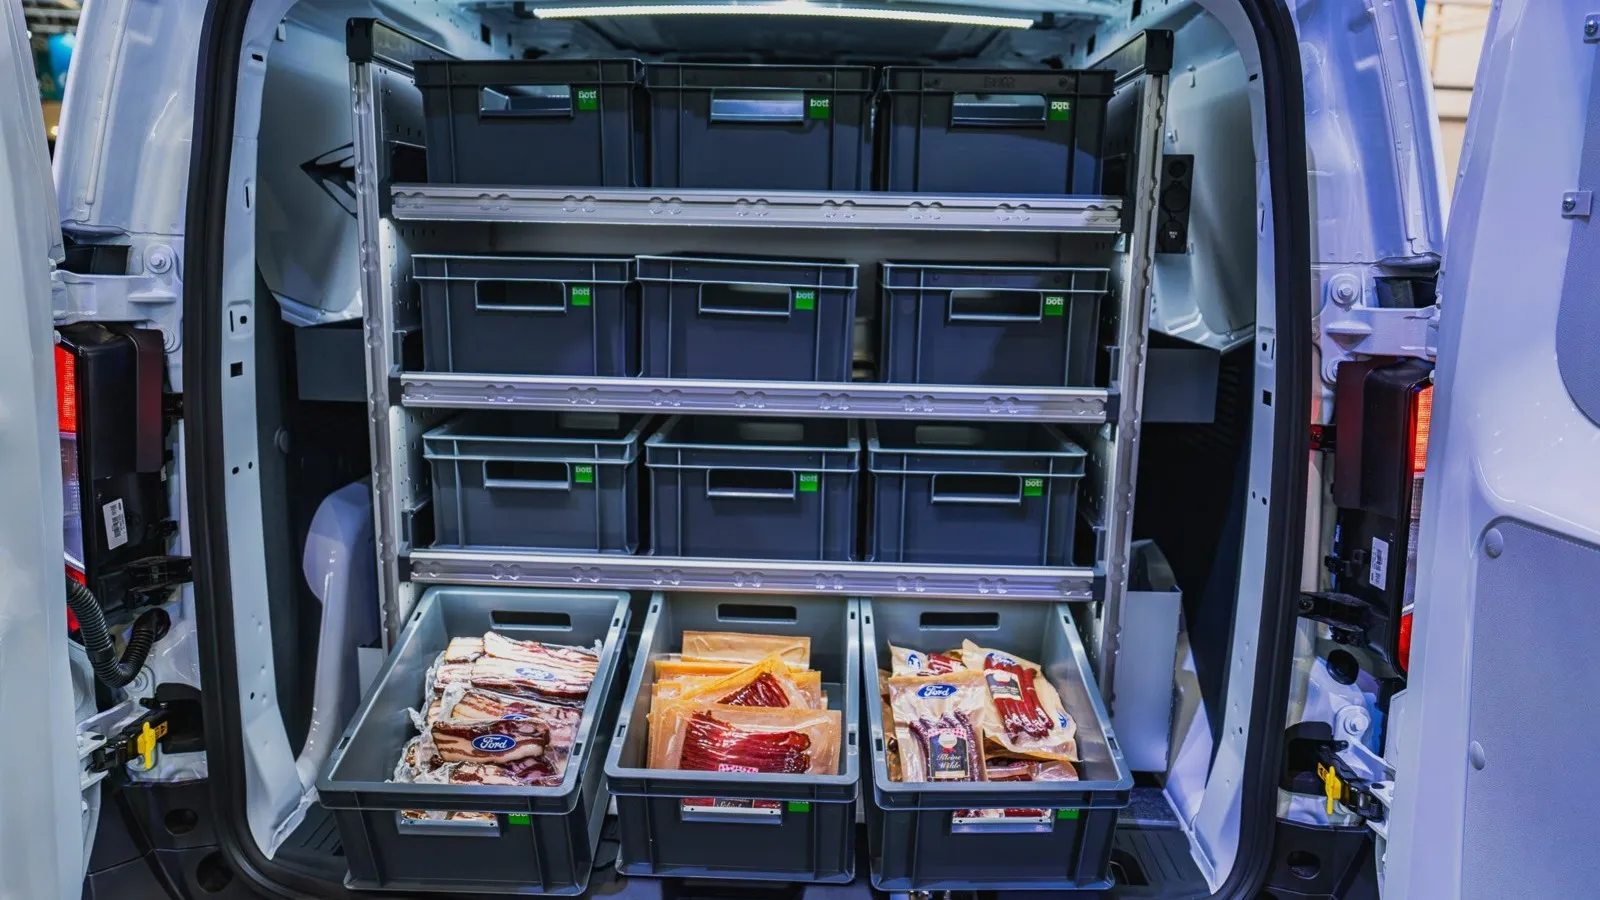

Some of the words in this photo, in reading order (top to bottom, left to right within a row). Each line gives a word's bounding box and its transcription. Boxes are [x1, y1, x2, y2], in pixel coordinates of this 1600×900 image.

[810, 98, 830, 108] bott
[572, 287, 591, 296] bott
[796, 291, 815, 300] bott
[1046, 297, 1064, 306] bott
[575, 465, 592, 473] bott
[800, 474, 818, 482] bott
[1025, 479, 1043, 487] bott
[924, 685, 950, 697] Ford
[480, 736, 508, 749] Ford
